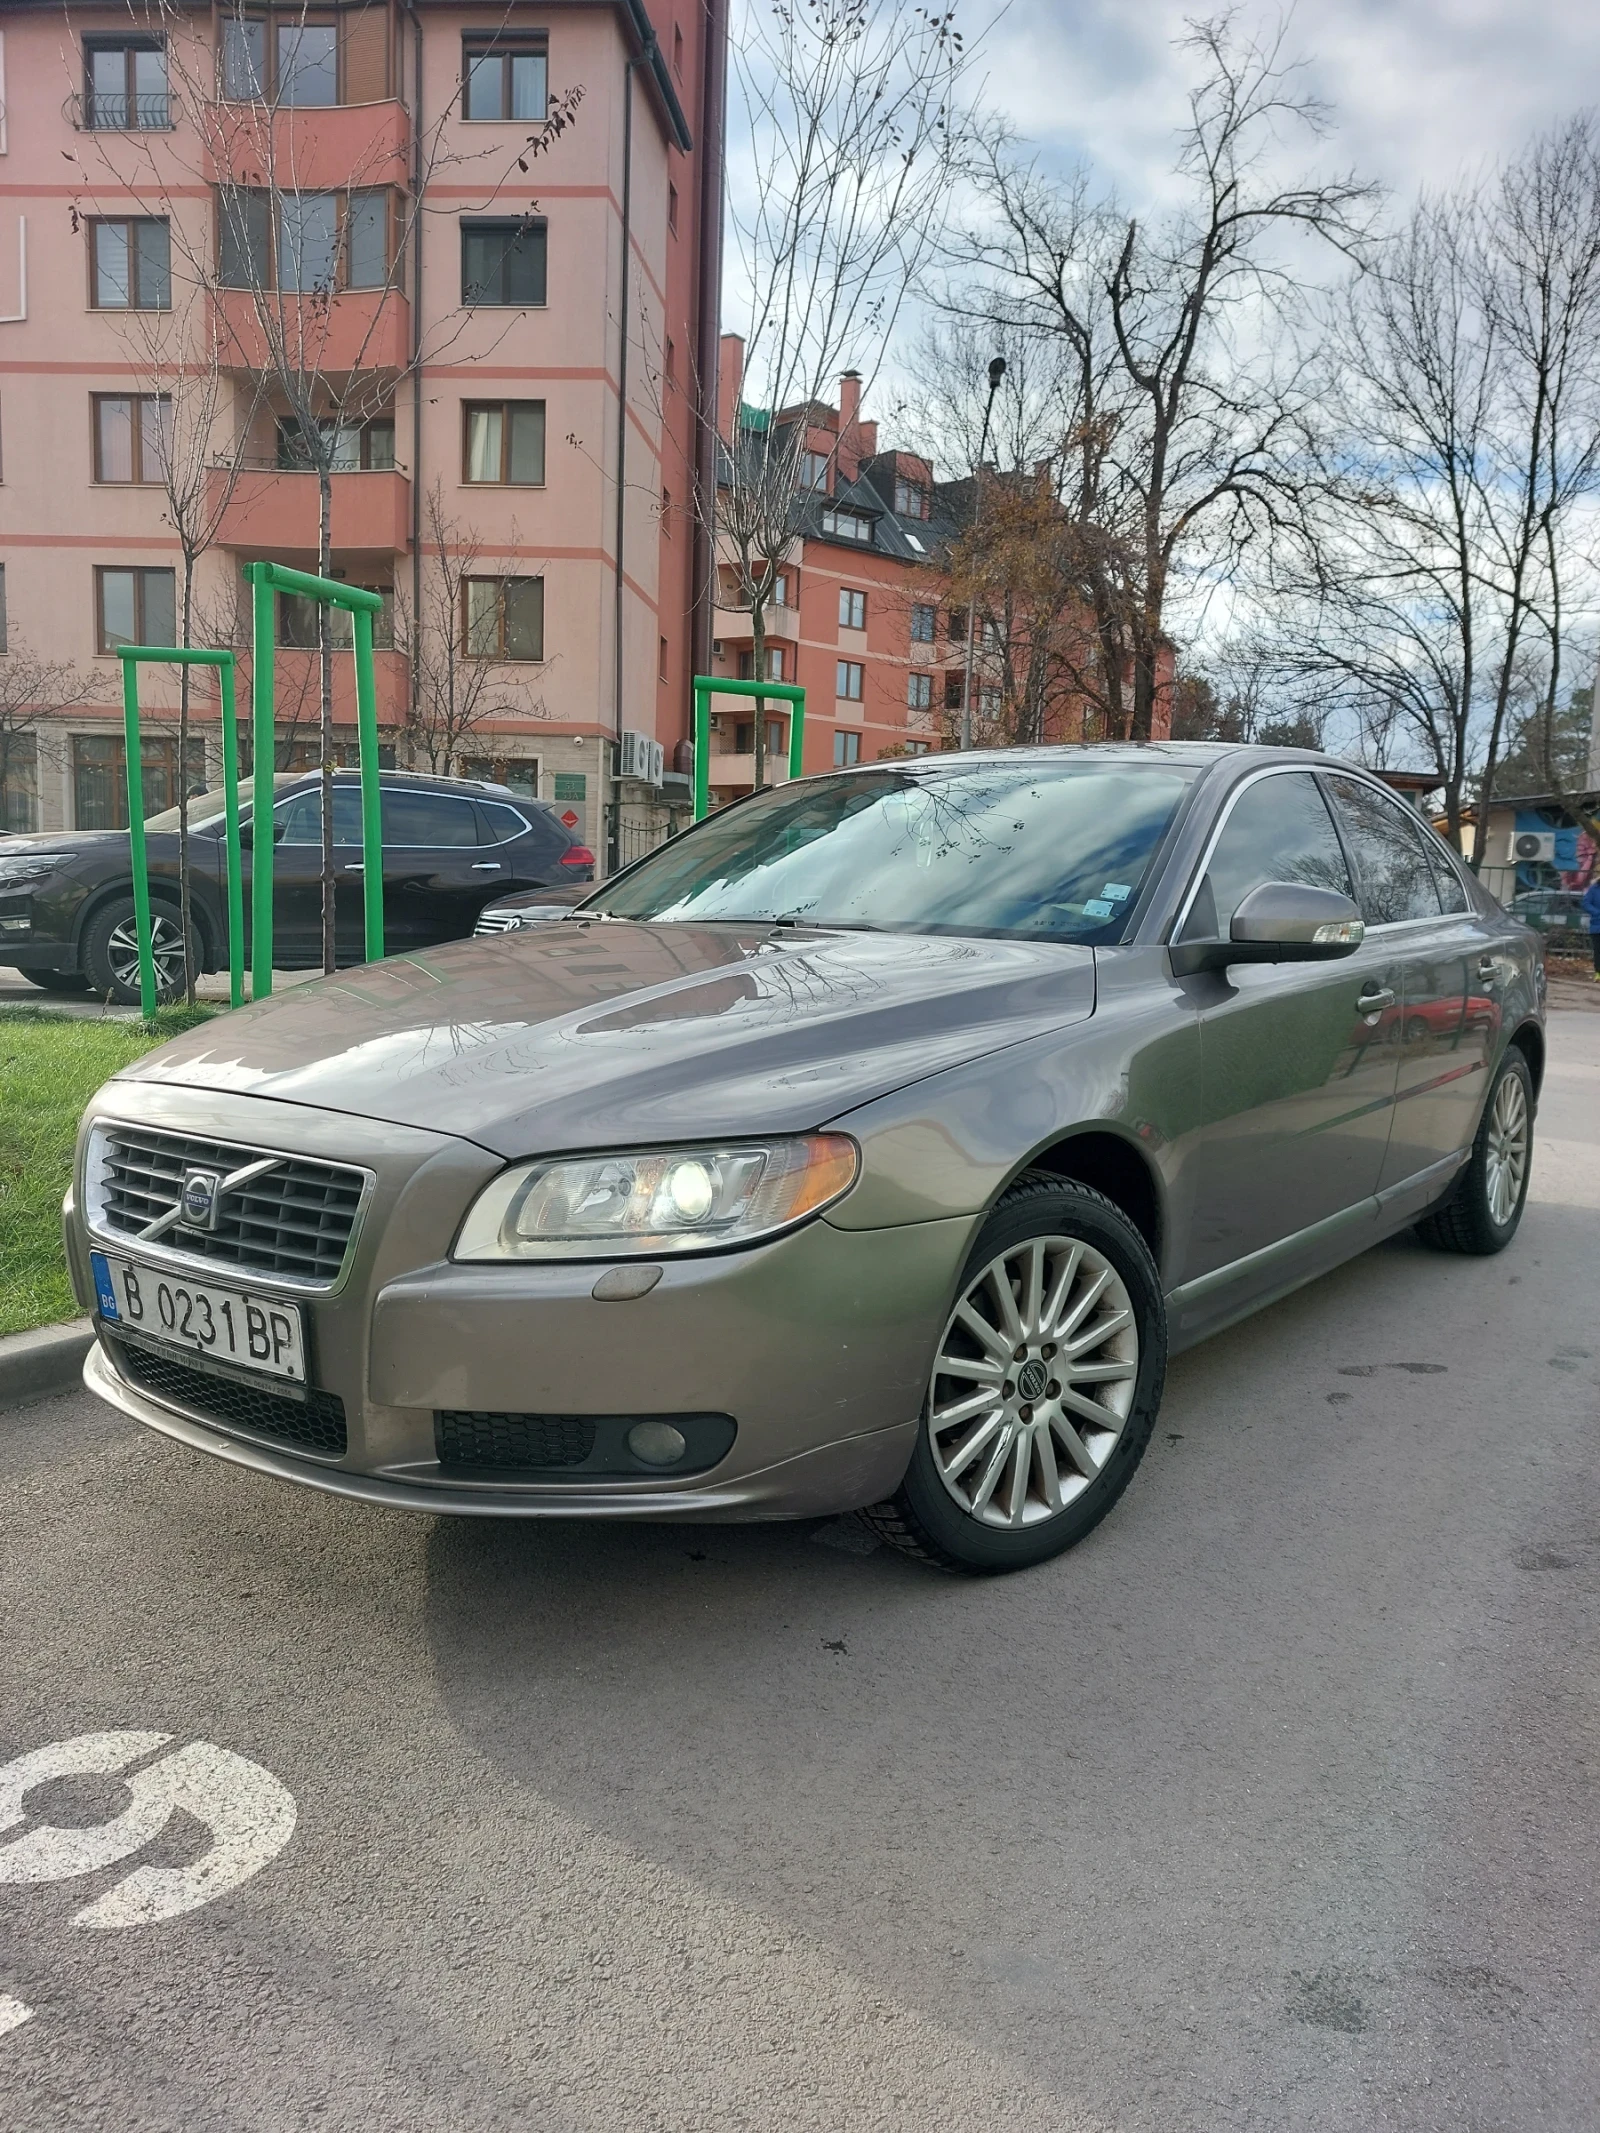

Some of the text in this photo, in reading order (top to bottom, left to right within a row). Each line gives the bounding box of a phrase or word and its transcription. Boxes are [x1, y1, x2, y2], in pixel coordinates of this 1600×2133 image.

[186, 1193, 209, 1205] VOLVO
[102, 1293, 115, 1310] BG
[122, 1269, 292, 1364] B 0231 BP
[1026, 1366, 1041, 1394] VOLVO
